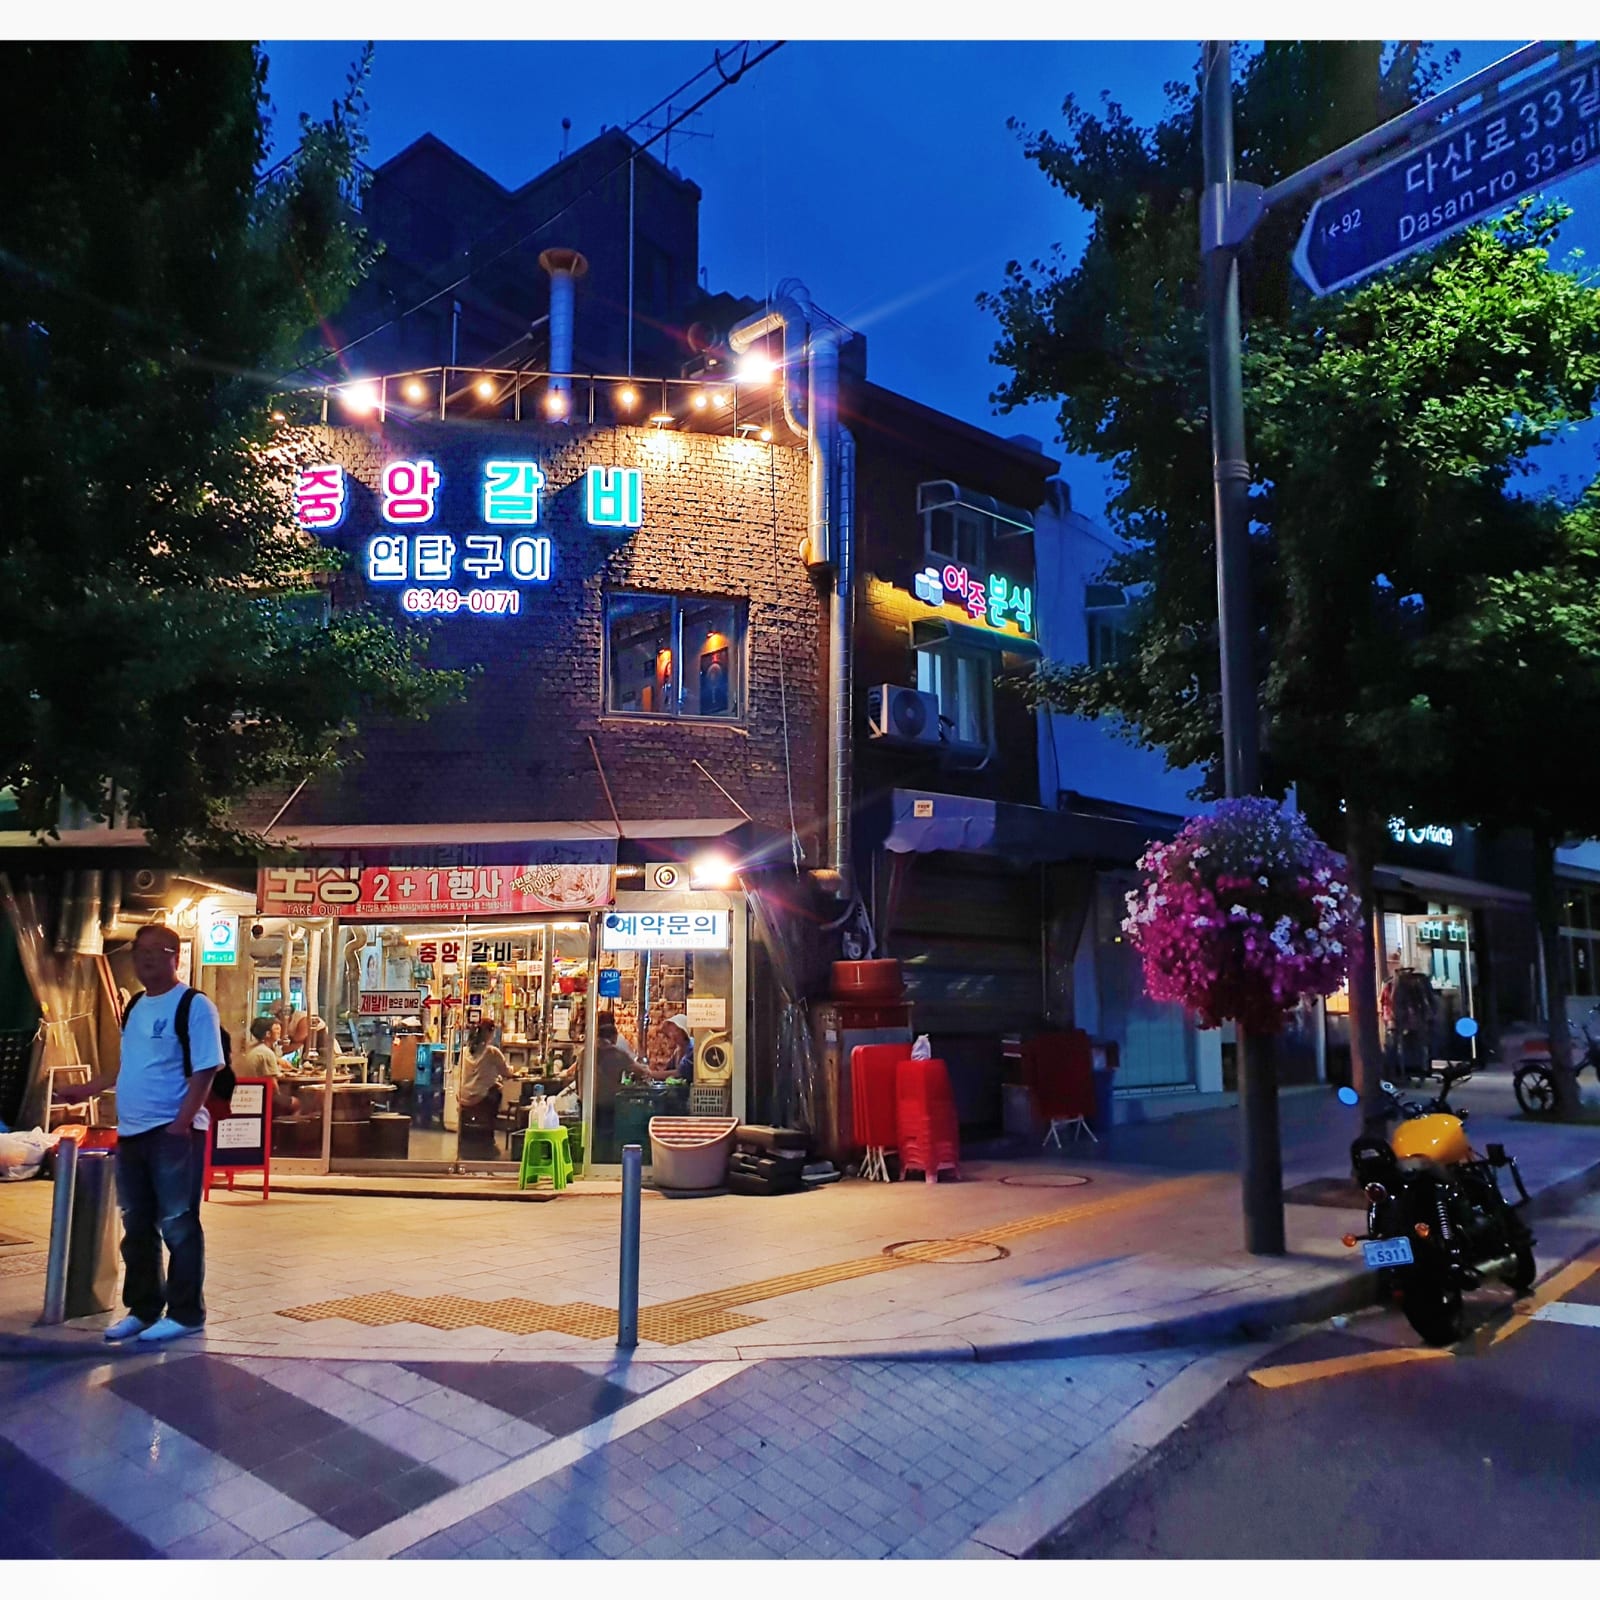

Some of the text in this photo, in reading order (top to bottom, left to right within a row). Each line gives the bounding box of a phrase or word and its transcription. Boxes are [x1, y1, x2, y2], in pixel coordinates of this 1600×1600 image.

[1400, 169, 1516, 241] Dasan-ro
[1341, 208, 1363, 234] 92
[369, 535, 551, 581] 연탄구이
[404, 588, 519, 614] 6349-0071
[447, 869, 502, 900] 행사
[286, 904, 342, 916] TAKE OUT
[614, 915, 717, 936] 예약문의
[1377, 1248, 1407, 1262] 5311
